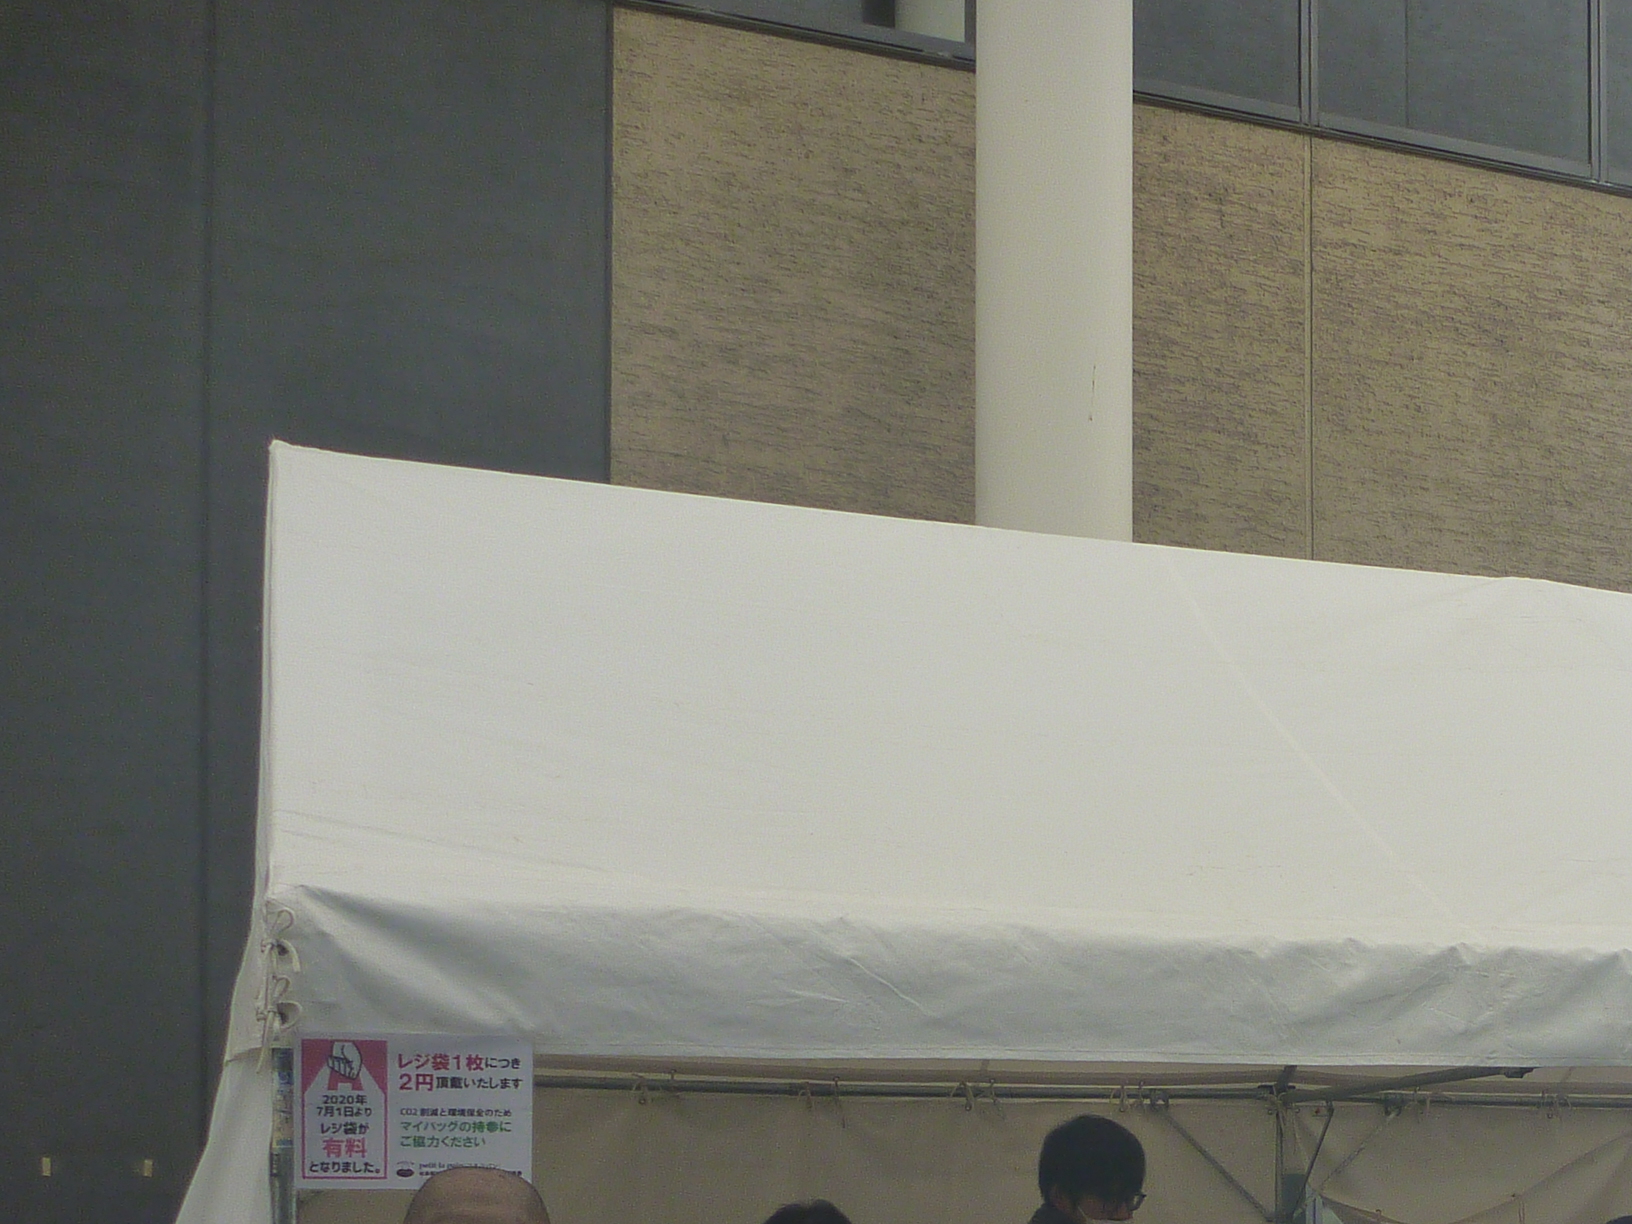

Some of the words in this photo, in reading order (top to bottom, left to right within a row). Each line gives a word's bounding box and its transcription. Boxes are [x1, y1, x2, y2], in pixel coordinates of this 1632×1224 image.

[398, 1053, 521, 1071] レジ袋1枚につき
[398, 1073, 523, 1092] 2円頂戴いたします
[322, 1094, 367, 1105] 2020年
[317, 1106, 372, 1117] 7月1日より
[320, 1122, 370, 1135] レジ袋が
[322, 1138, 367, 1158] 有料
[400, 1135, 486, 1148] ご協力ください
[309, 1162, 380, 1174] となりました。
